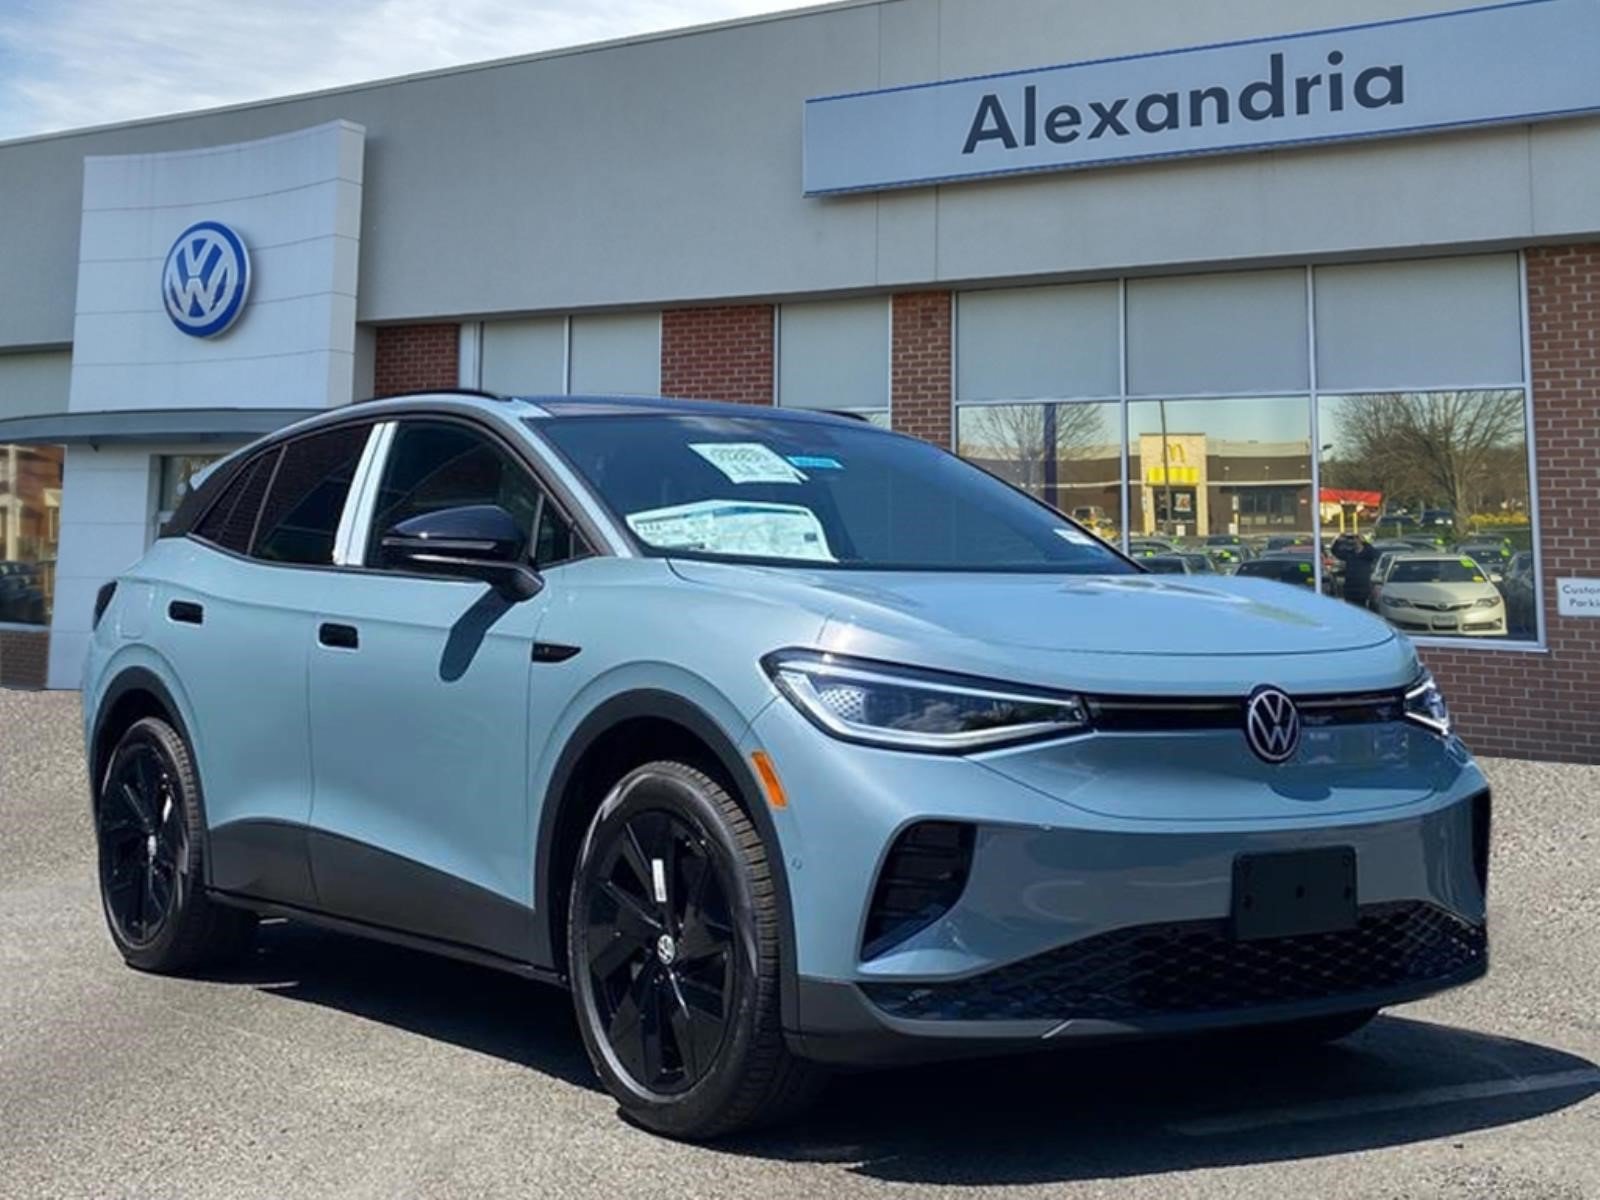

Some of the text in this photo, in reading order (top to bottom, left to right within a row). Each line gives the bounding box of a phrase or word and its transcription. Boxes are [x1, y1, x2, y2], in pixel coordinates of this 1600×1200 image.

[962, 51, 1405, 155] Alexandria
[165, 228, 240, 328] VW
[1248, 690, 1299, 760] VW
